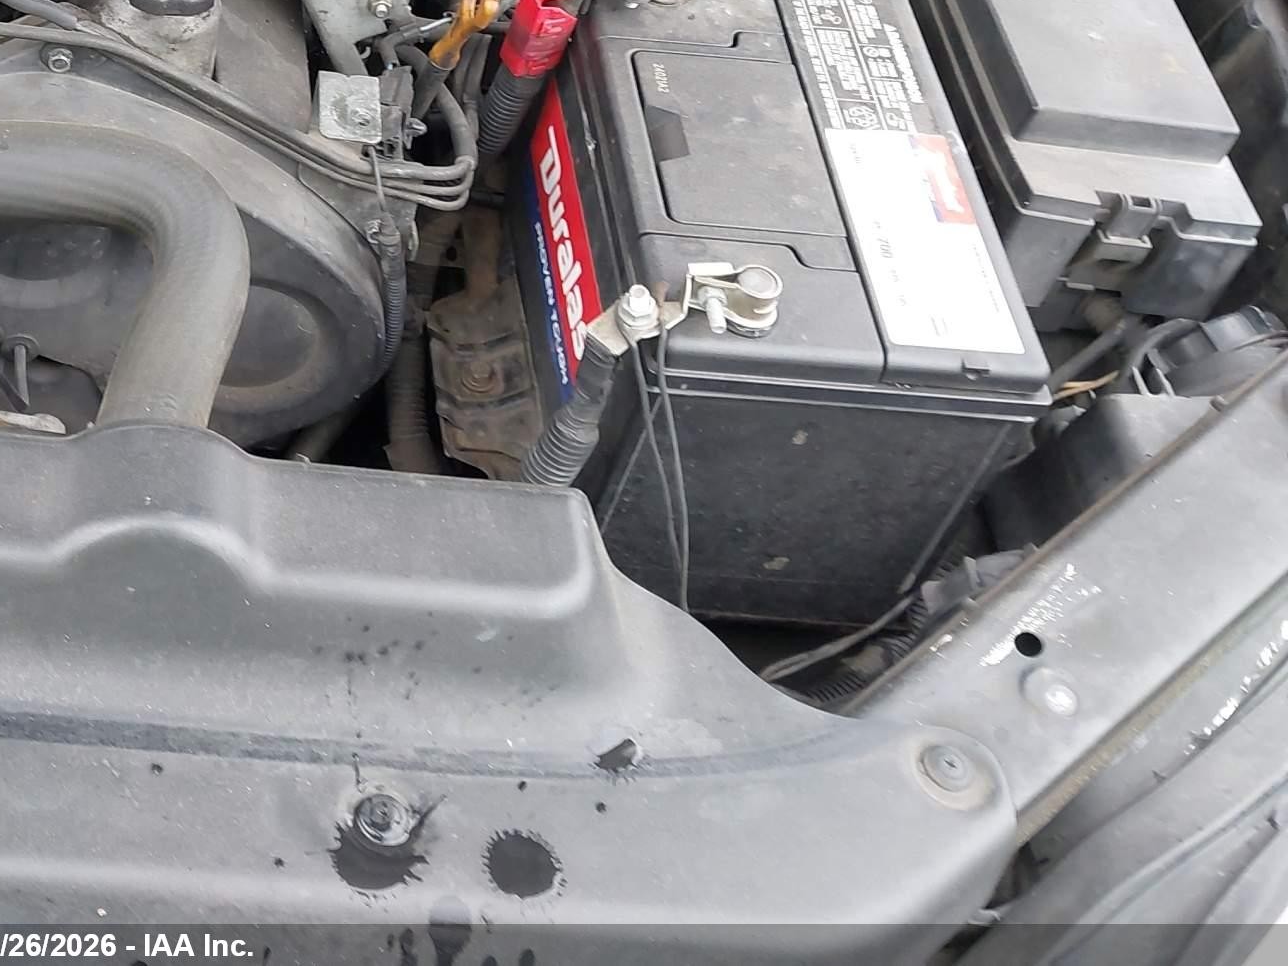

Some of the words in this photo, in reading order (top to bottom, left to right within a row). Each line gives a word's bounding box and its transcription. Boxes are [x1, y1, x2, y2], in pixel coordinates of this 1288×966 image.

[534, 221, 555, 307] PROVEN
[550, 311, 569, 385] TOUGH
[539, 125, 588, 361] Duralas
